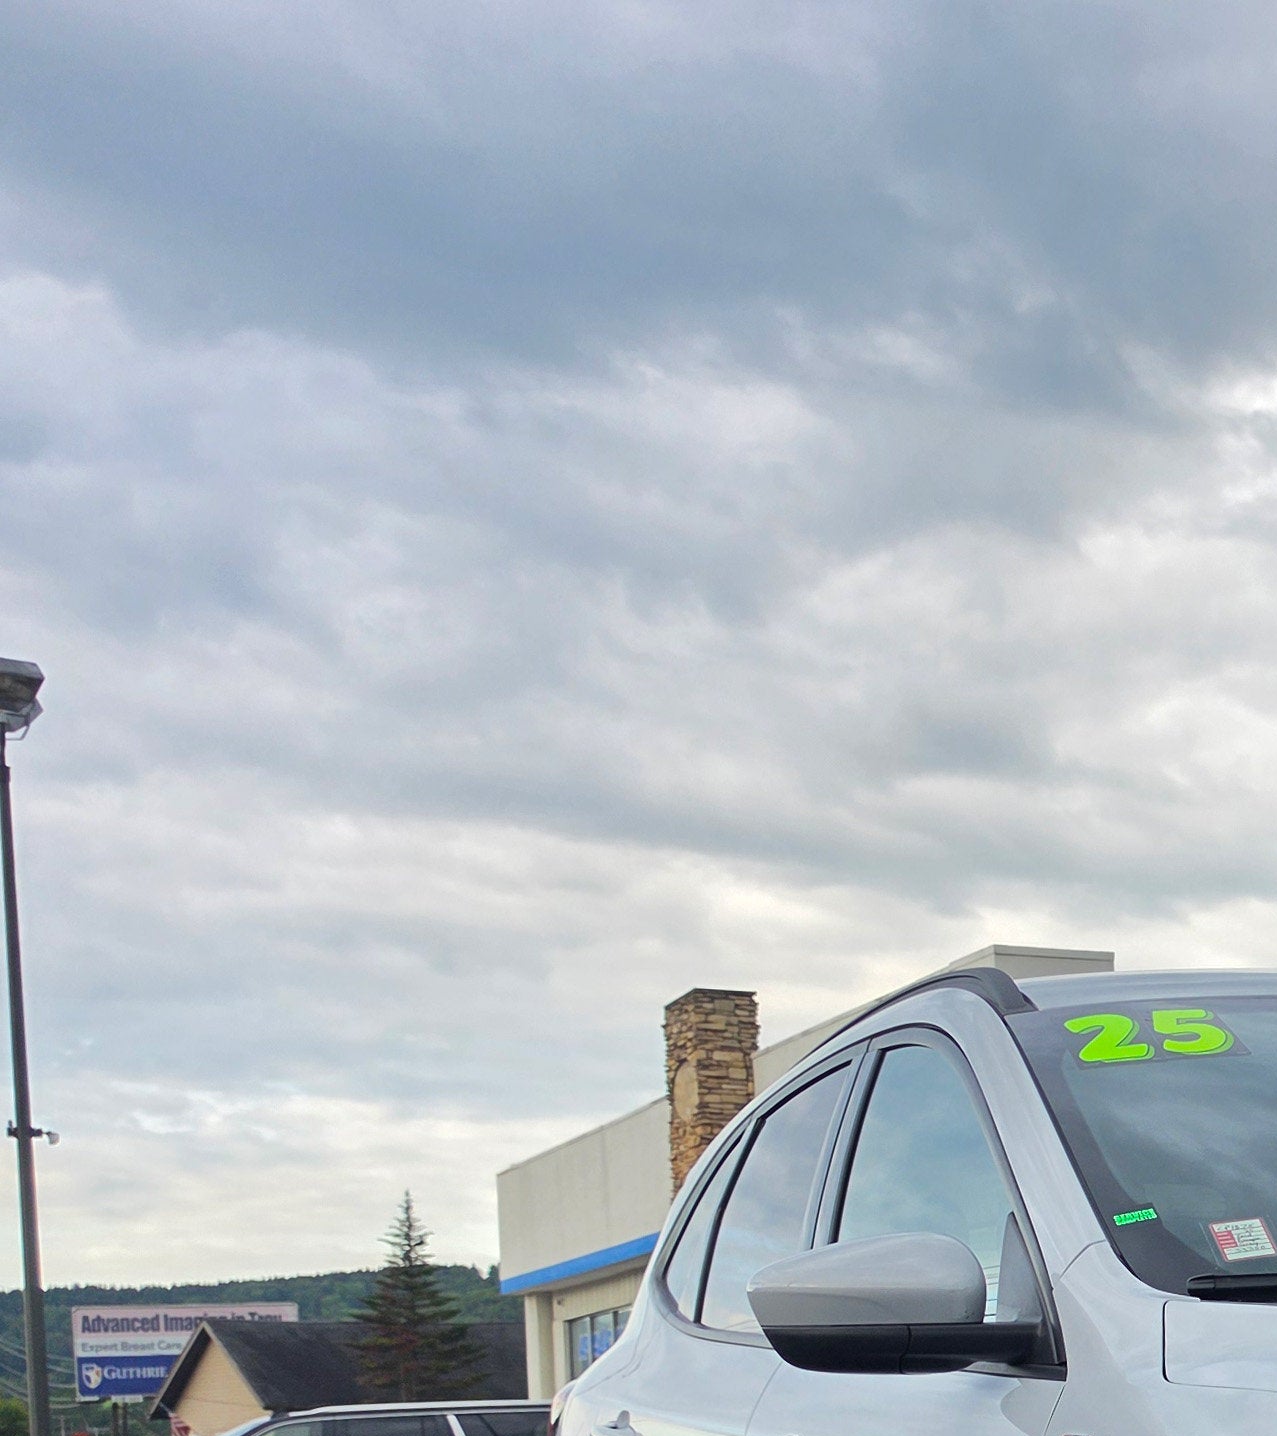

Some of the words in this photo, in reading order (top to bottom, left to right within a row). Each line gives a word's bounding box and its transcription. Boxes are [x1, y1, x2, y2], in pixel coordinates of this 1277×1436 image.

[1063, 1009, 1234, 1063] 25
[81, 1313, 160, 1333] Advanced
[81, 1341, 118, 1353] Expert
[119, 1340, 155, 1351] Breast
[157, 1340, 182, 1350] Care
